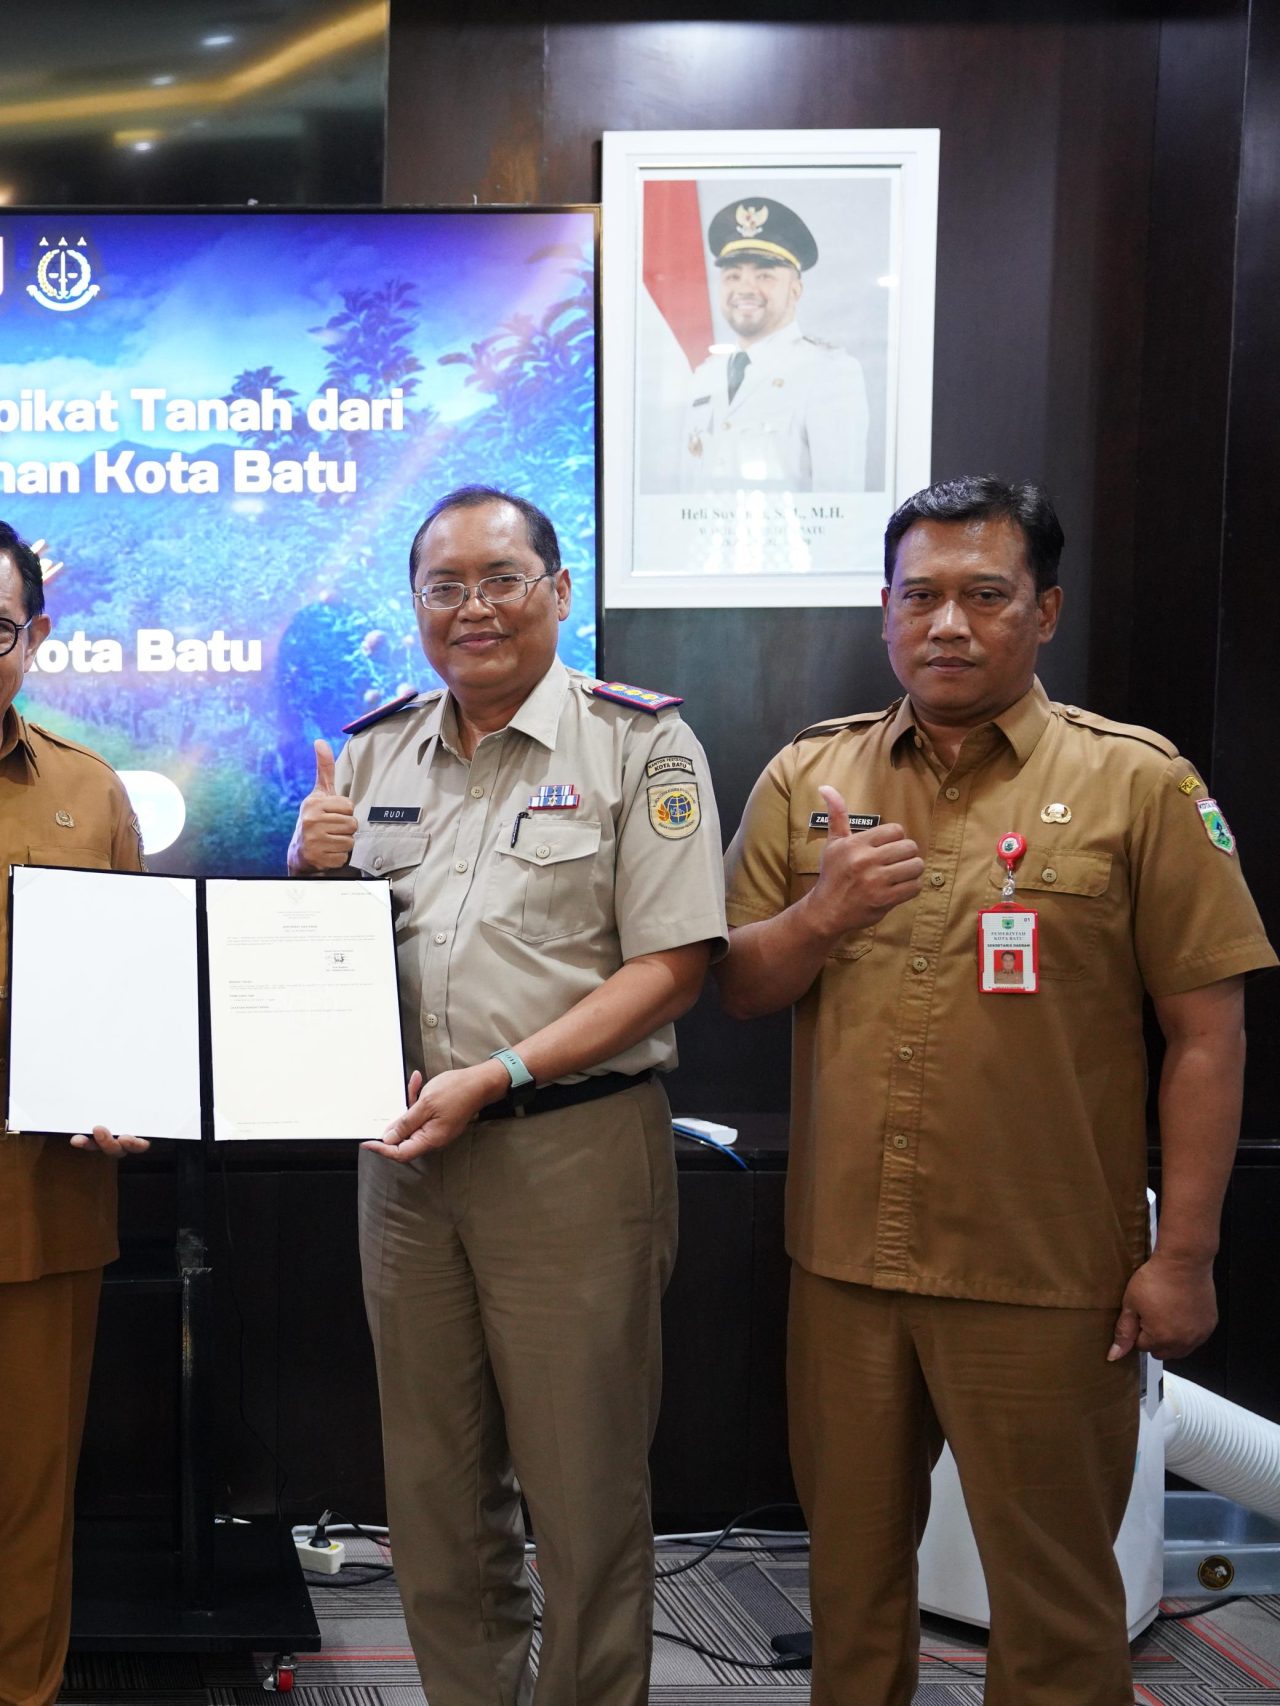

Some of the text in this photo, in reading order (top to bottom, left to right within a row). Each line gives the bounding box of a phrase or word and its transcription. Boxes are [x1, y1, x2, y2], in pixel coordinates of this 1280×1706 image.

[130, 387, 292, 432] Tanah
[307, 387, 404, 432] dari
[95, 450, 219, 495] Kota
[234, 449, 357, 494] Batu
[811, 507, 845, 519] M.H.
[28, 630, 123, 673] ota
[137, 629, 261, 673] Batu
[654, 763, 670, 771] KOTA
[383, 810, 405, 818] RUDI
